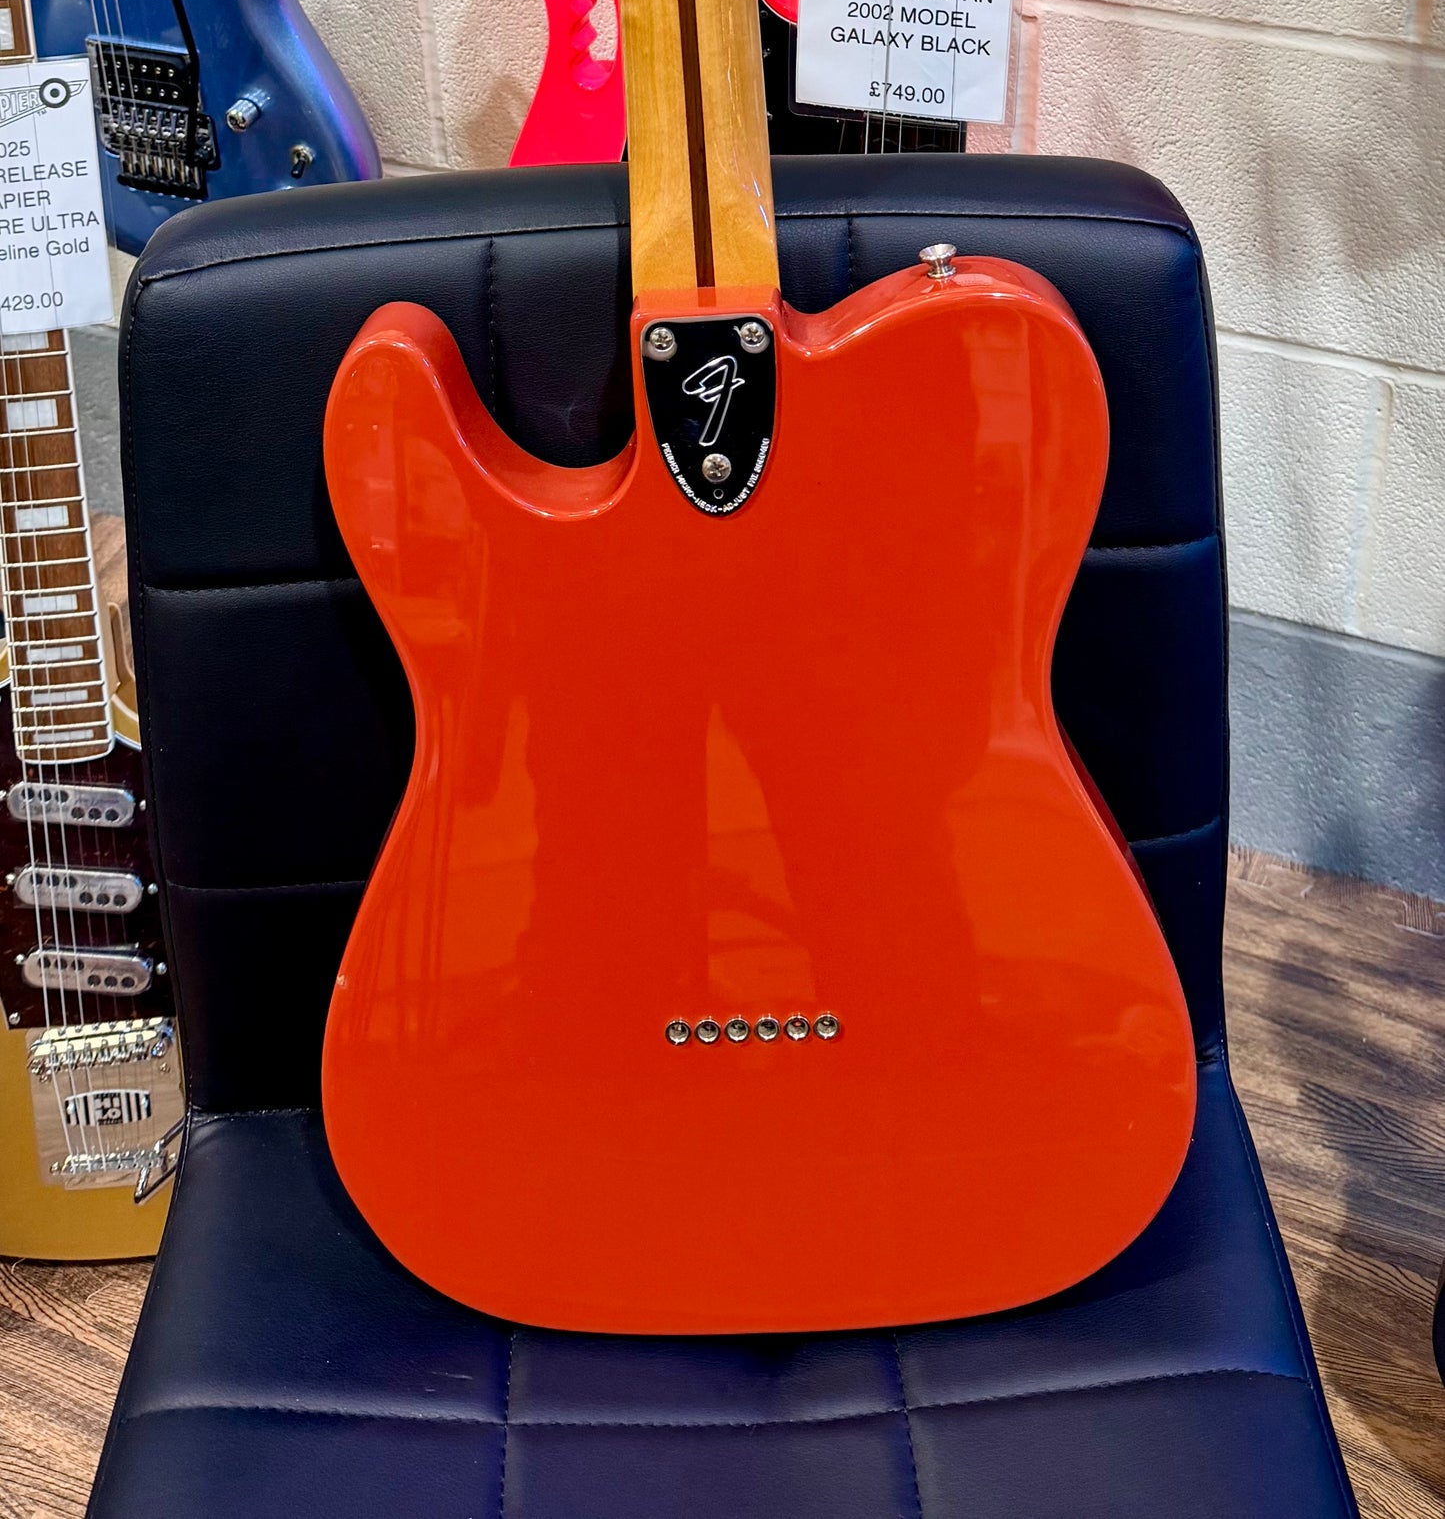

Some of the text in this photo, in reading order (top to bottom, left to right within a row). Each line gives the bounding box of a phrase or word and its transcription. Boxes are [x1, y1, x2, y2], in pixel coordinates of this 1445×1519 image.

[847, 2, 977, 29] 2002 MODEL
[830, 26, 991, 56] GALAXY BLACK
[869, 81, 945, 104] £749.00
[0, 190, 51, 209] PIER
[31, 210, 100, 232] ULTRA
[46, 236, 89, 256] Gold
